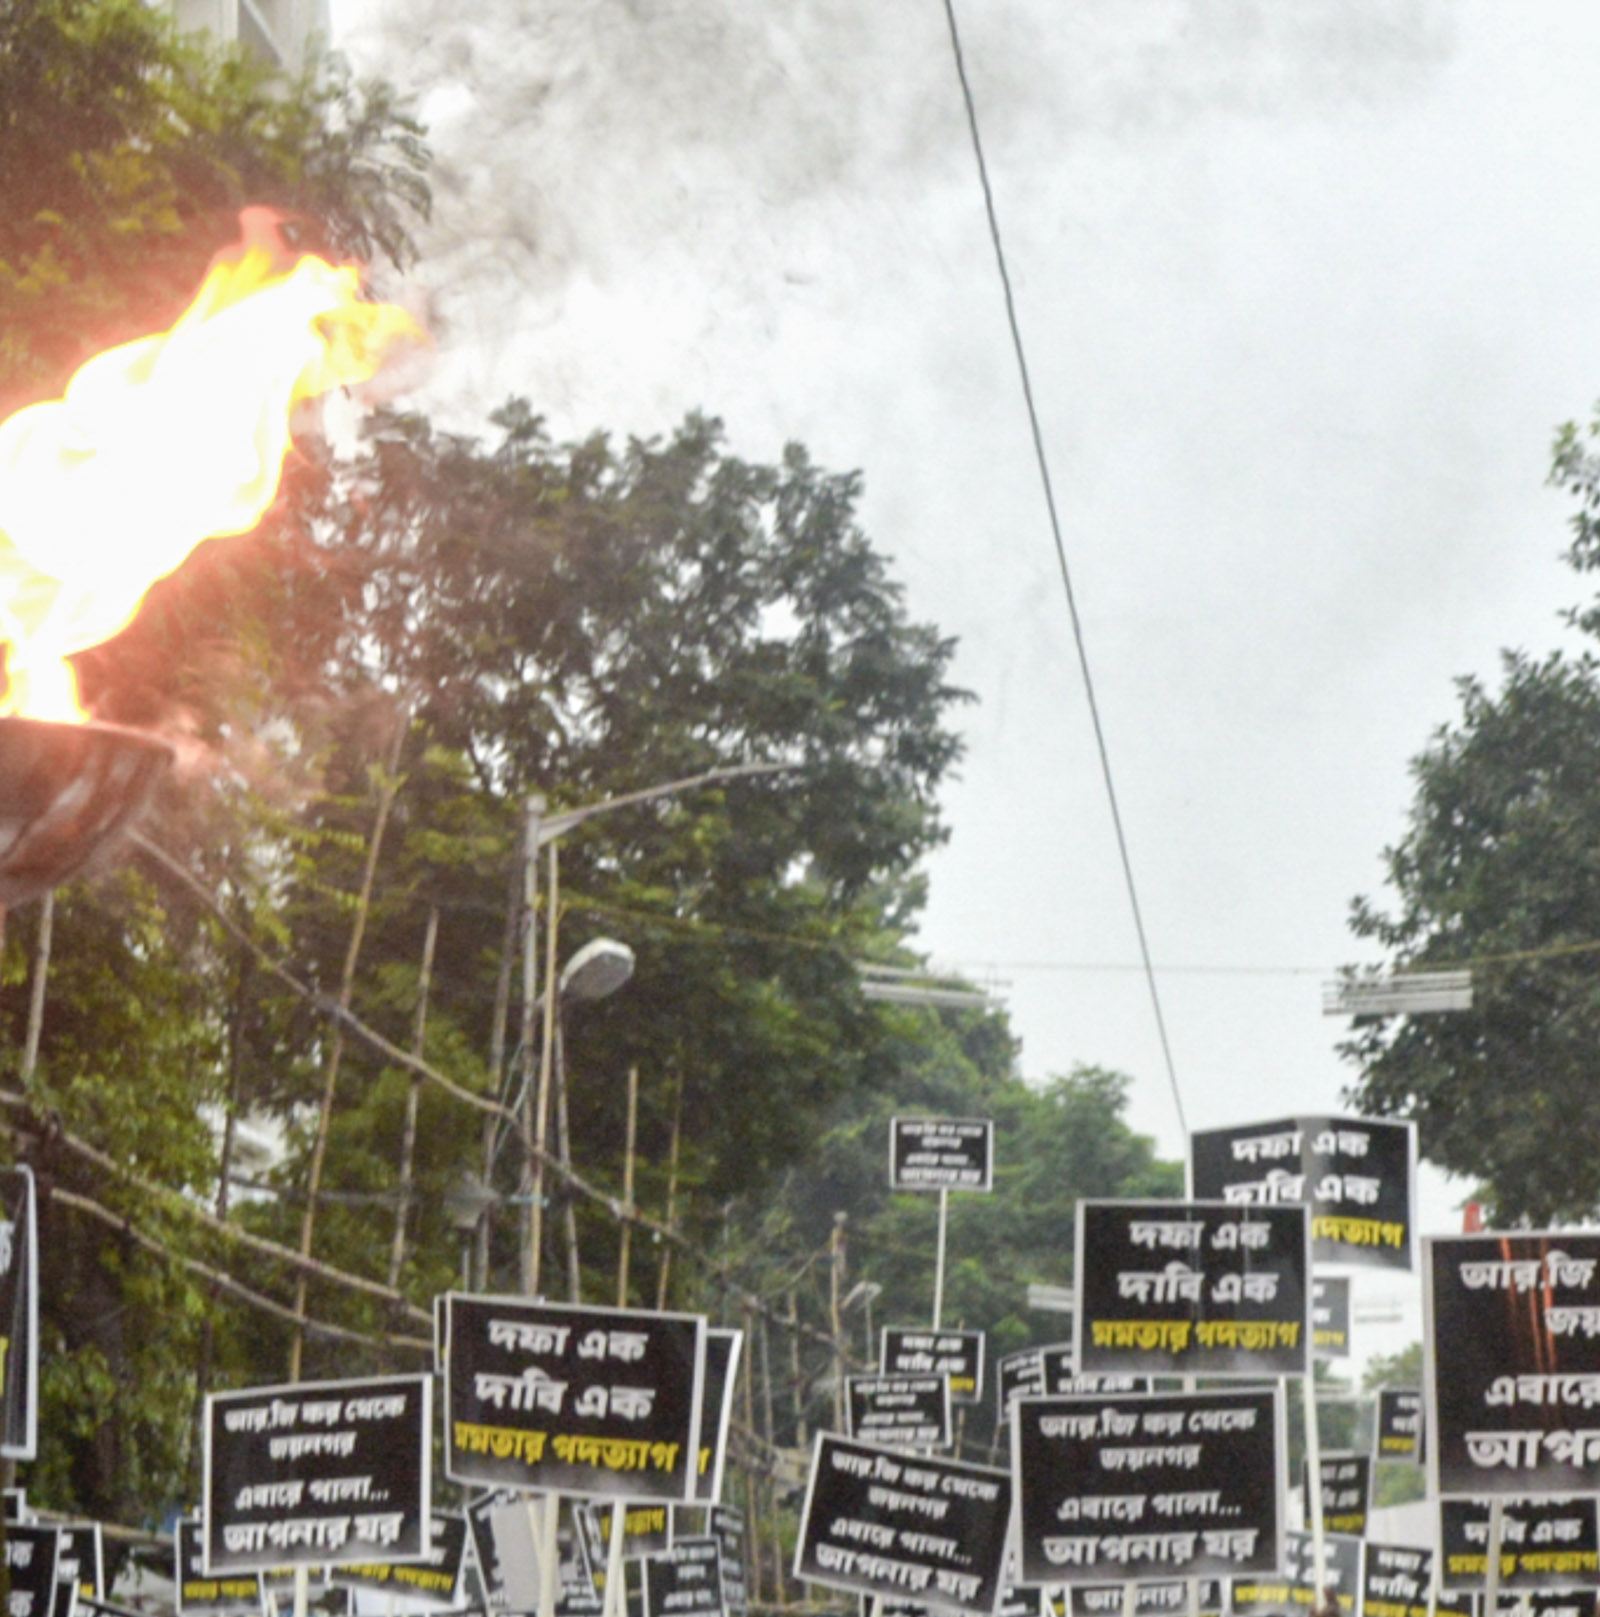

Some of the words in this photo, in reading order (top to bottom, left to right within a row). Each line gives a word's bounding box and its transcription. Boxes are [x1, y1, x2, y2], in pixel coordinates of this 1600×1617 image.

[1231, 1130, 1301, 1163] দফা
[1311, 1128, 1370, 1157] এক
[1314, 1174, 1380, 1205] এক
[1129, 1221, 1205, 1250] দফা
[1211, 1222, 1272, 1250] এক
[1117, 1259, 1204, 1304] দাবি
[1211, 1271, 1279, 1303] এক
[489, 1319, 571, 1356] দফা
[577, 1329, 649, 1363] এক
[1091, 1320, 1191, 1353] মমতার
[1195, 1320, 1301, 1349] পদত্যাগ
[474, 1366, 569, 1415] দাবি
[575, 1384, 656, 1421] এক
[1142, 1411, 1185, 1436] কর
[1188, 1408, 1257, 1432] থেকে
[454, 1421, 547, 1466] মমতার
[552, 1434, 679, 1474] পদত্যাগ
[1057, 1495, 1146, 1523] এবারে
[223, 1515, 350, 1552] আপনার
[353, 1512, 404, 1547] ঘর
[1042, 1532, 1198, 1565] আপনার
[1201, 1528, 1259, 1562] ঘর
[816, 1542, 935, 1592] আপনার
[936, 1569, 983, 1603] ঘর
